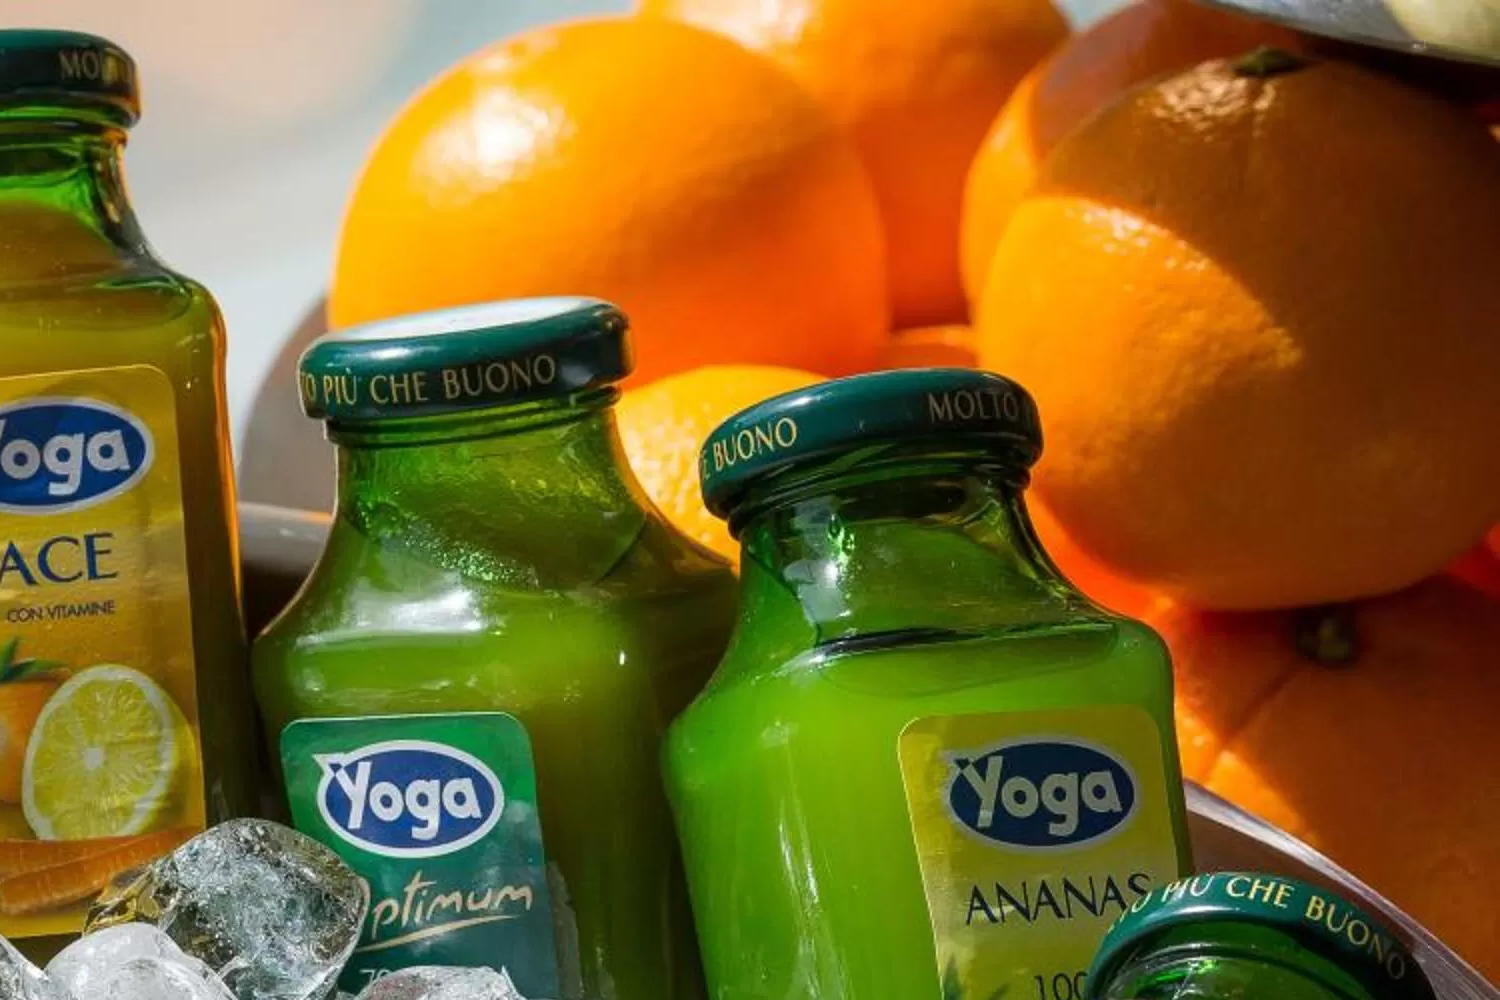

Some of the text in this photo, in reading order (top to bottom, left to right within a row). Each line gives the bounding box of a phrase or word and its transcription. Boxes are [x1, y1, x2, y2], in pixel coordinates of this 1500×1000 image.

[323, 367, 357, 404] PIÙ
[370, 372, 429, 404] CHE
[443, 355, 555, 399] BUONO
[928, 391, 1019, 423] MOLTO
[713, 417, 797, 472] BUONO
[7, 600, 116, 622] CON VITAMINE
[334, 761, 482, 840] Yoga
[960, 755, 1123, 837] Yoga
[370, 870, 533, 940] ptimum
[965, 873, 1152, 925] ANANAS
[1226, 876, 1295, 908] CHE
[1304, 896, 1405, 981] BUONO
